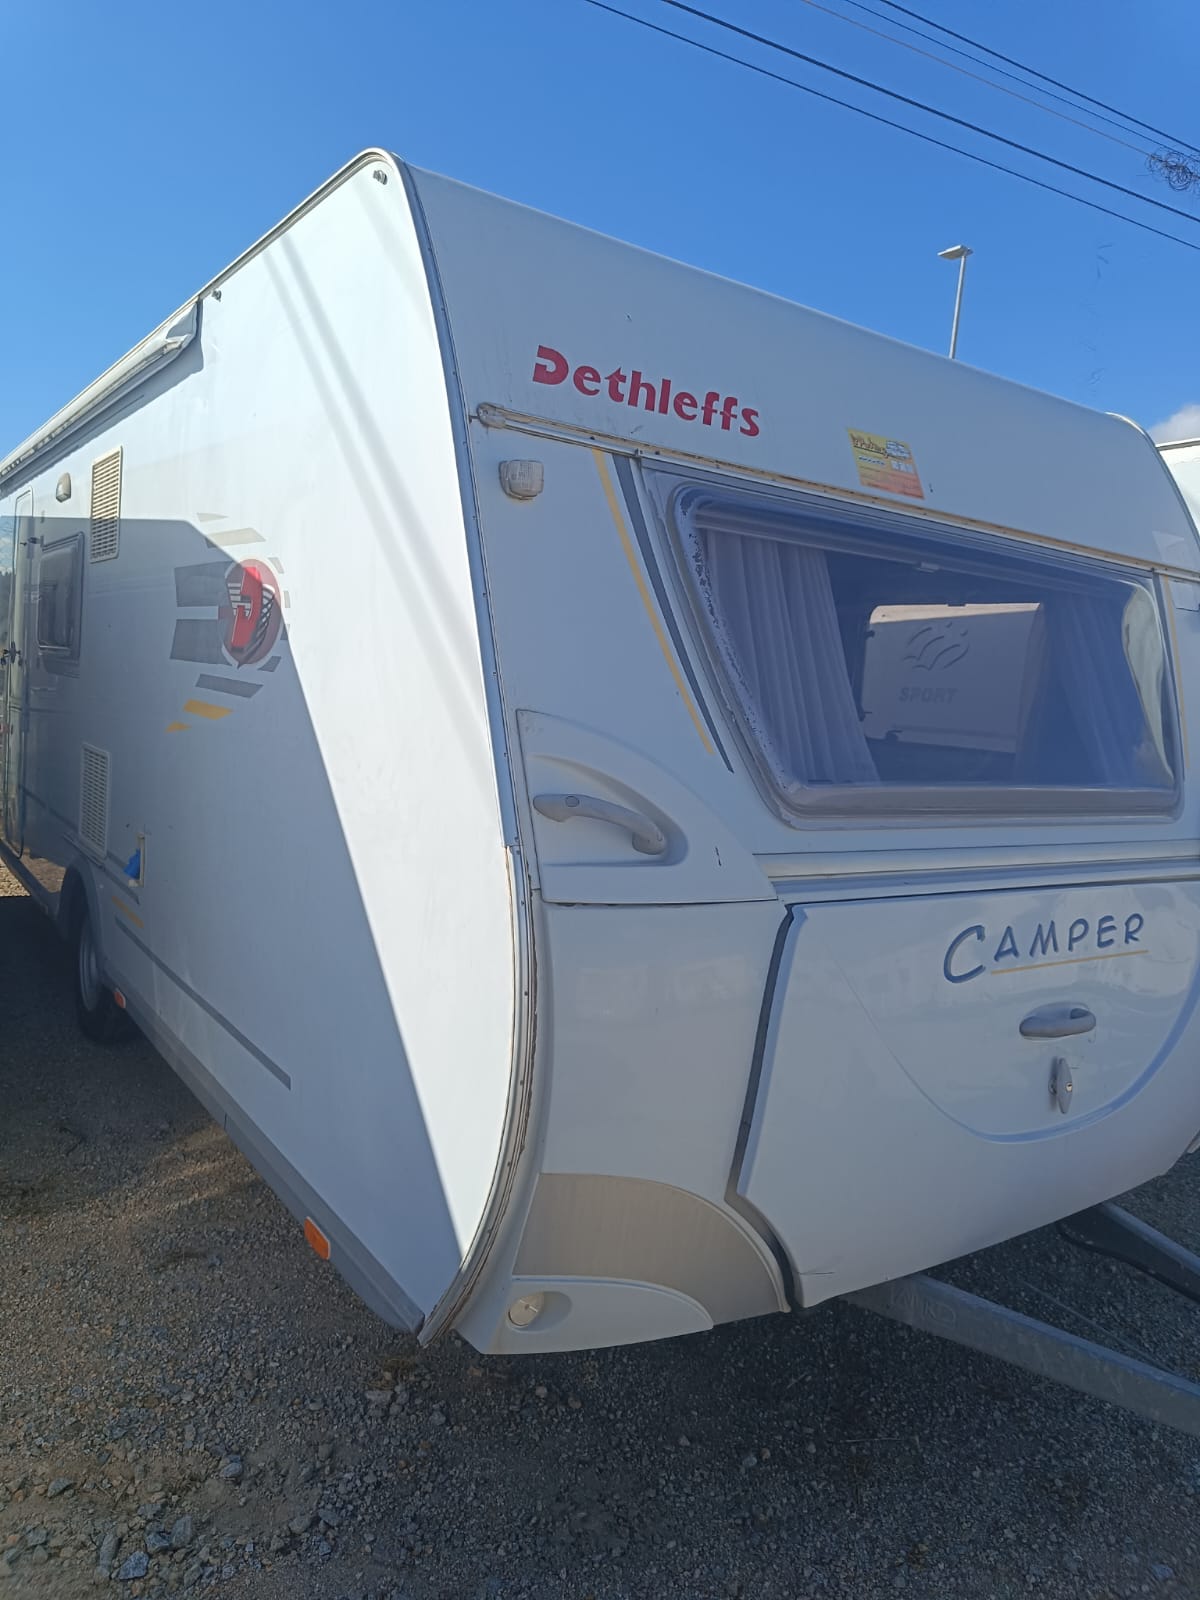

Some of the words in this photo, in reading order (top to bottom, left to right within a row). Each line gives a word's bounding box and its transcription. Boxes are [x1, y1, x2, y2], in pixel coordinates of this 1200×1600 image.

[533, 345, 760, 437] Dethleffs
[898, 687, 958, 704] SPORT
[943, 912, 1145, 984] CAMPER
